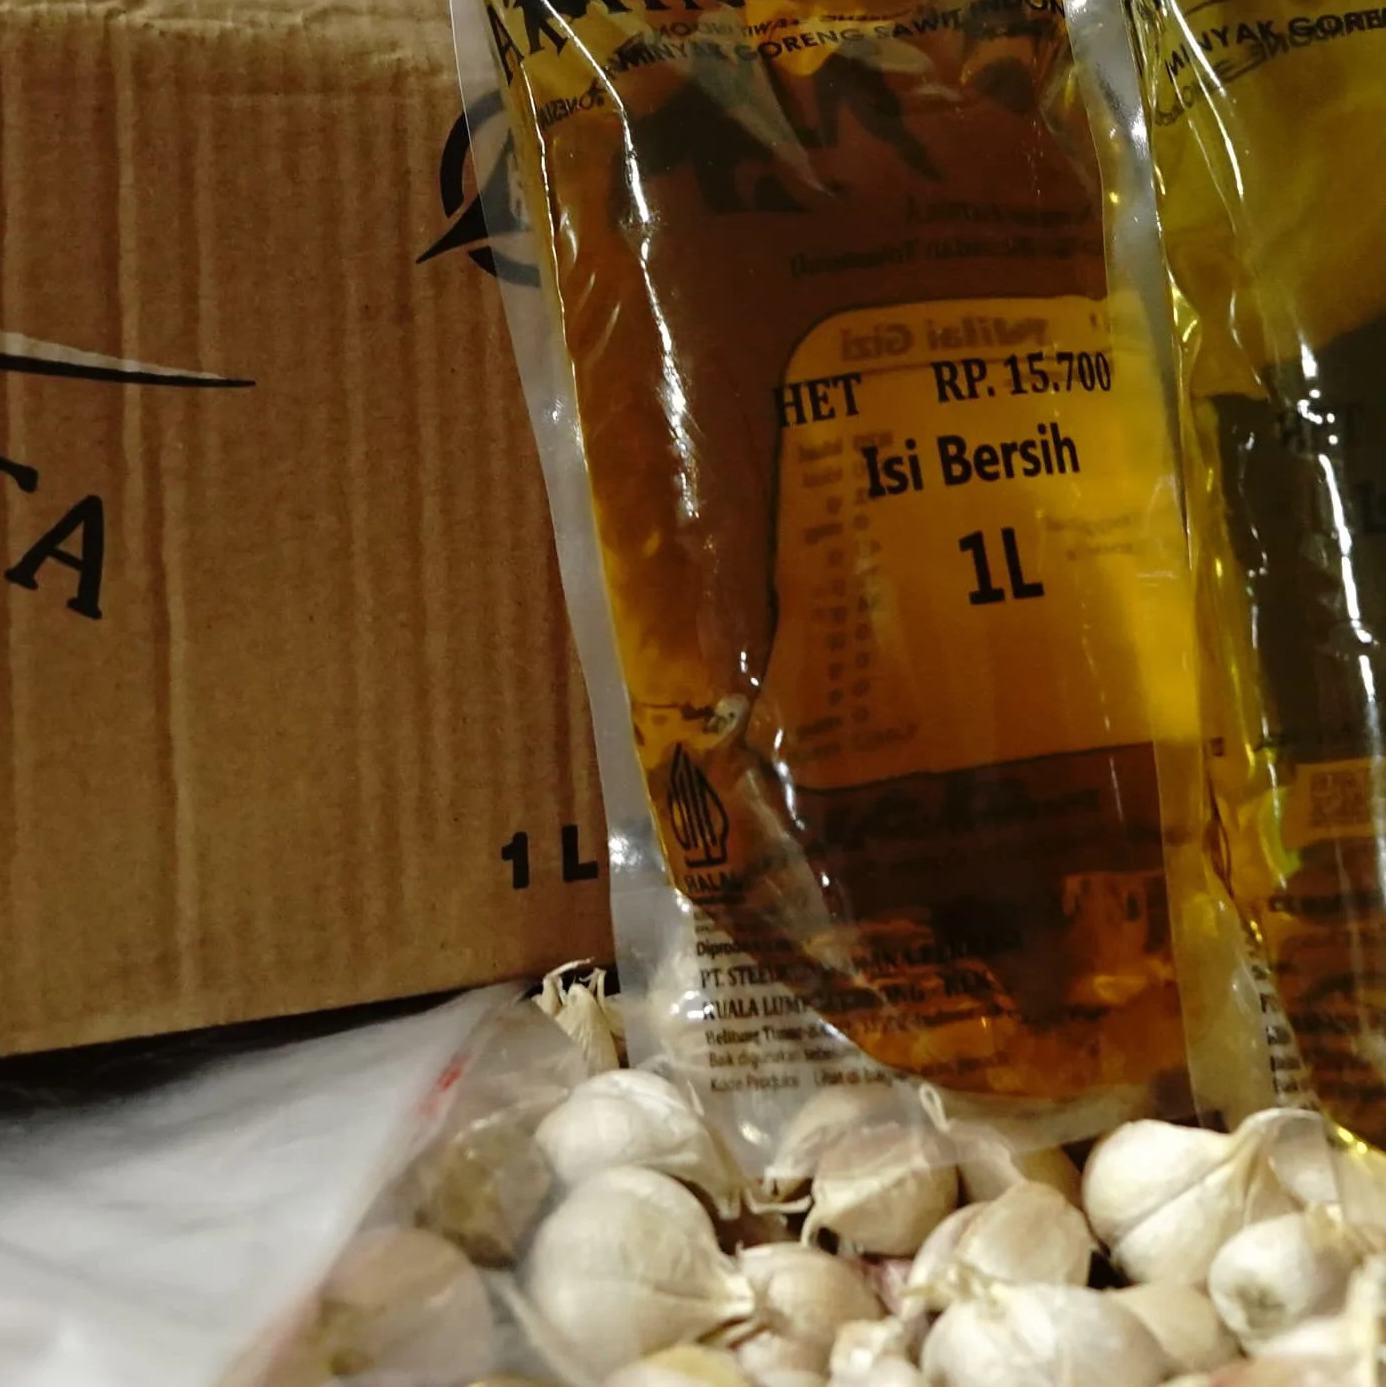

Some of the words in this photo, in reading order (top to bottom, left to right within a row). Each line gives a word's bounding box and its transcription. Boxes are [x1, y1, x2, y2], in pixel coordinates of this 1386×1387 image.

[772, 372, 863, 429] HET
[932, 359, 995, 404] RP.
[1008, 350, 1113, 396] 15.700
[860, 438, 924, 499] Isi
[938, 422, 1081, 487] Bersih
[958, 526, 1045, 606] 1L
[499, 830, 530, 888] 1
[561, 825, 600, 882] L
